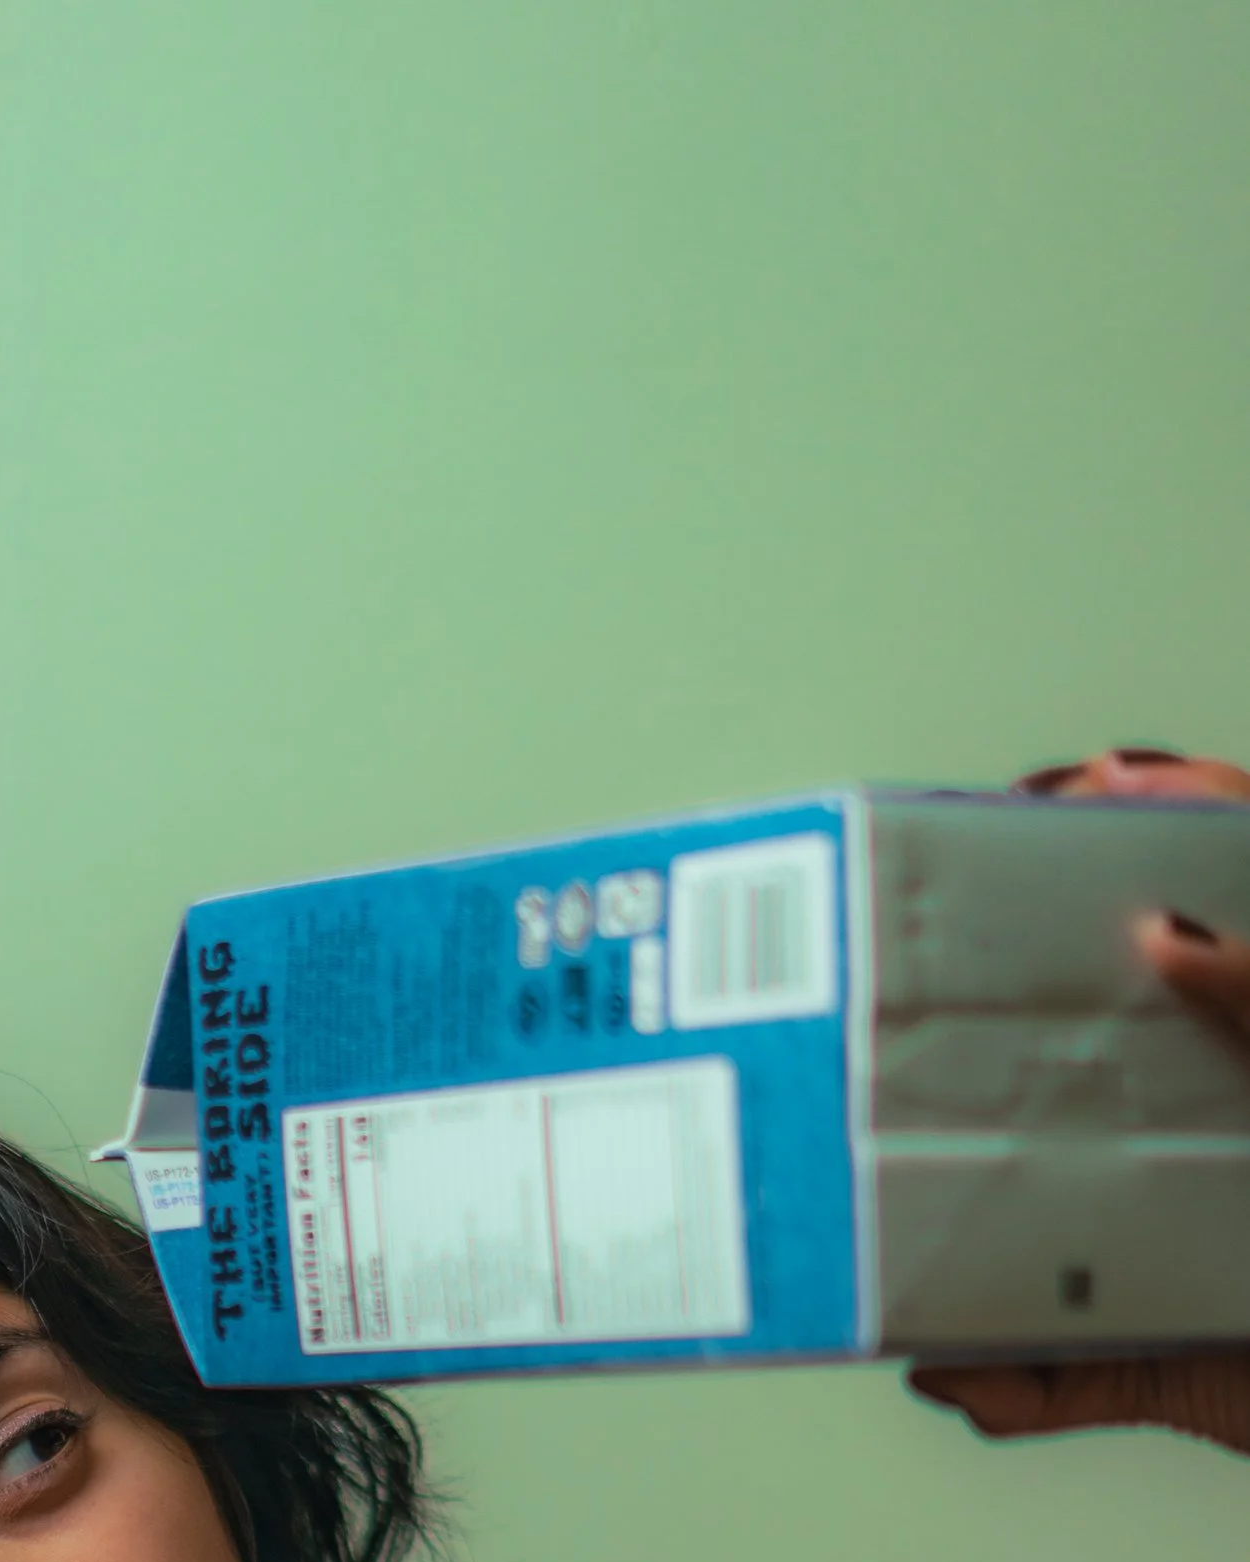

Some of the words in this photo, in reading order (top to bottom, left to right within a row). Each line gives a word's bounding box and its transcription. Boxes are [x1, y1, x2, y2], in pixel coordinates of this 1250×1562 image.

[199, 941, 236, 1184] BORING
[236, 985, 271, 1143] SIDE
[244, 1174, 260, 1235] VERY
[293, 1121, 313, 1200] Facts
[209, 1205, 244, 1341] THE
[297, 1212, 325, 1345] Nutrition
